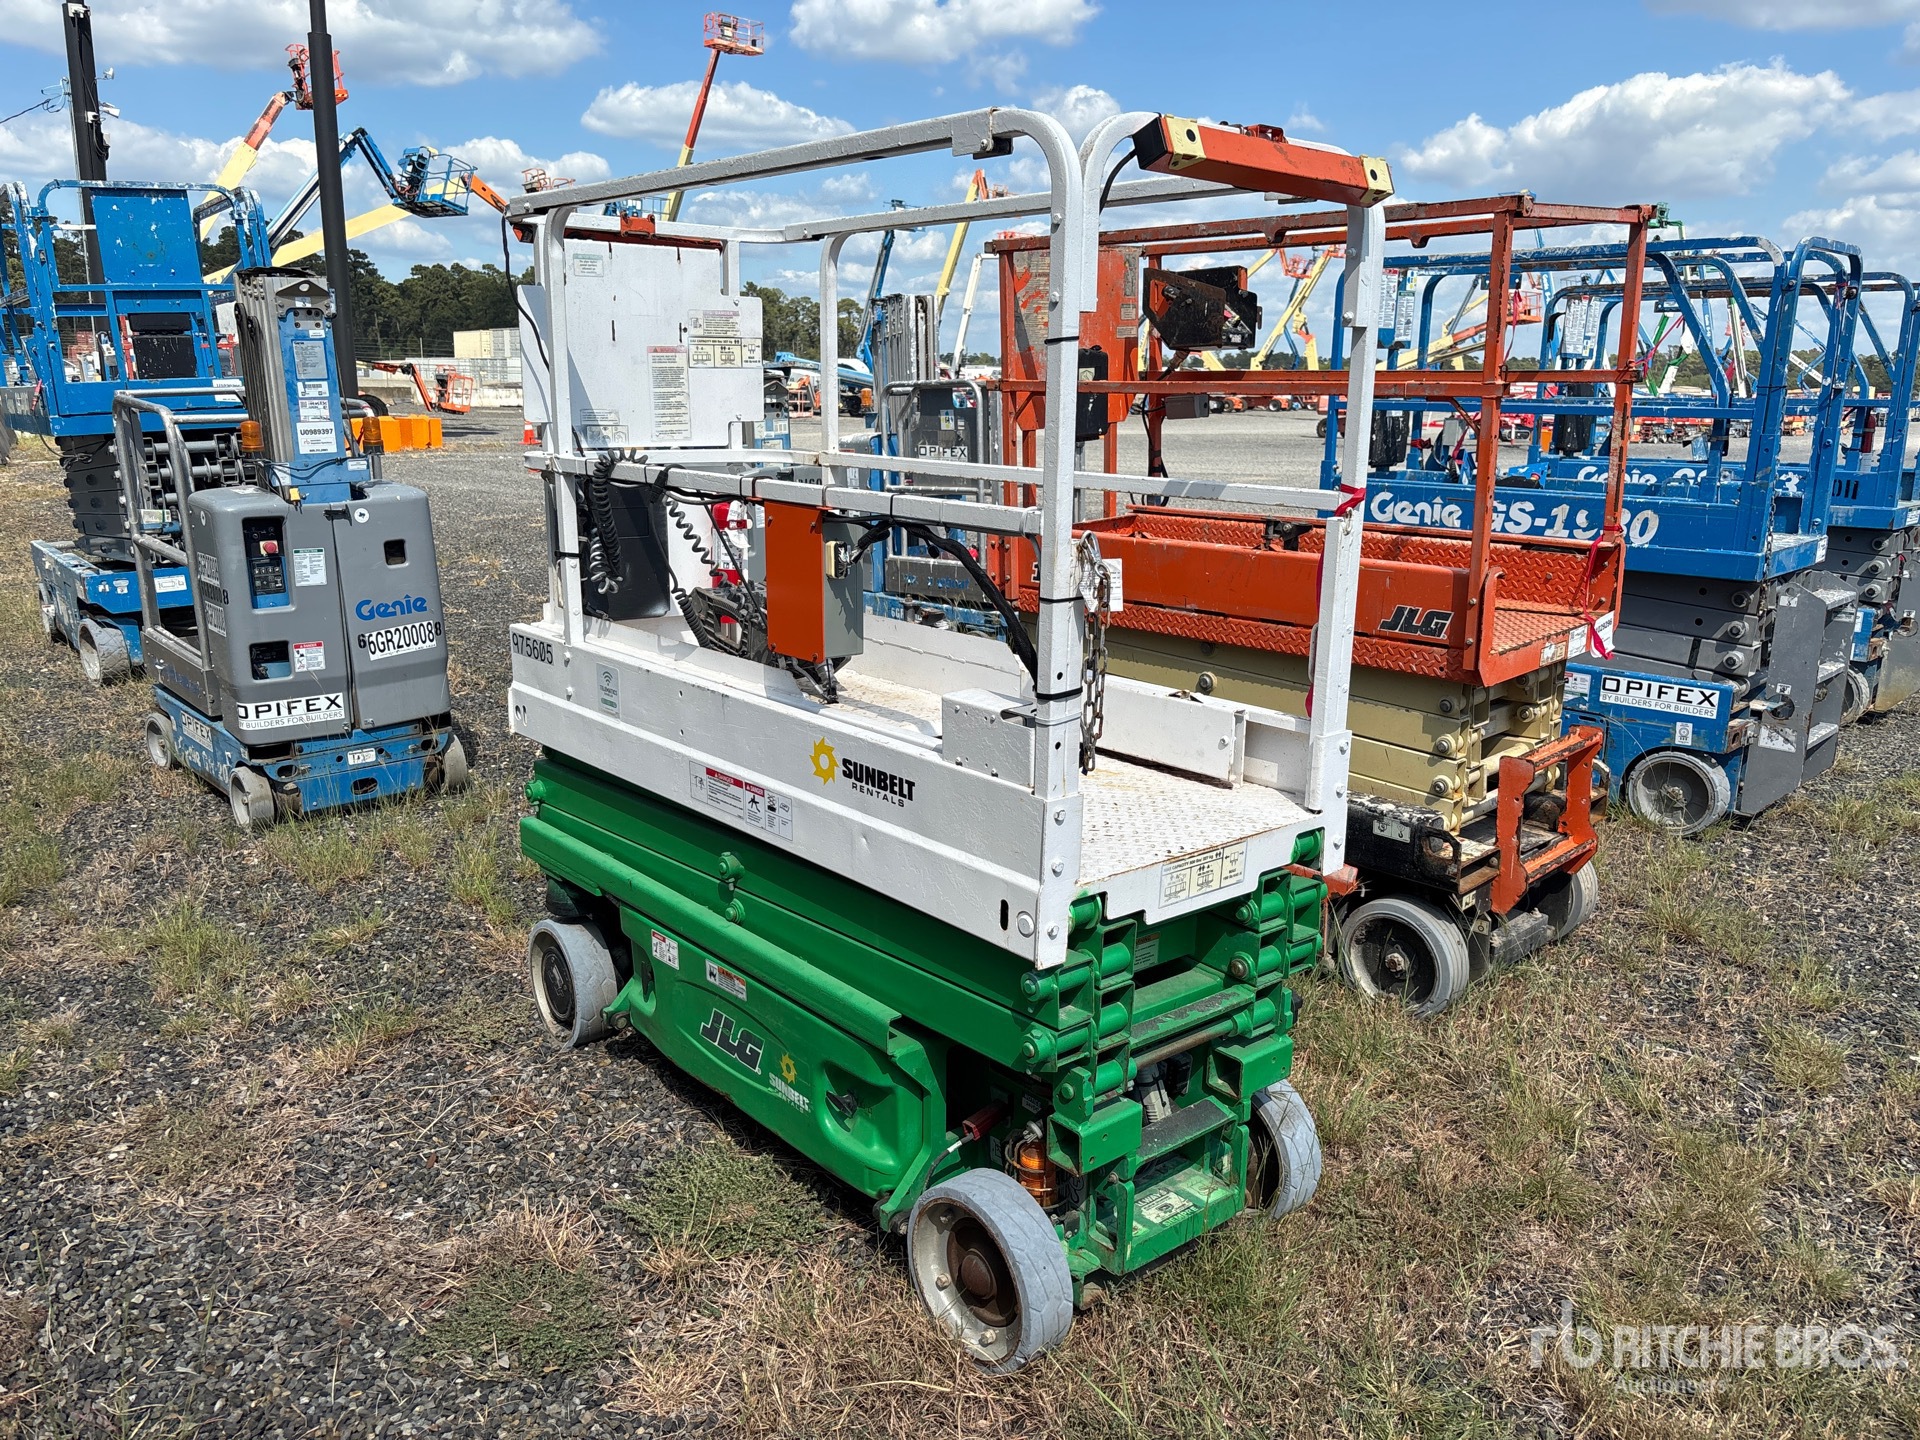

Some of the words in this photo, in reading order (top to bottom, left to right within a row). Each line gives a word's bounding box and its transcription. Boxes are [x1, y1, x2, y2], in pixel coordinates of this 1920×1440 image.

[299, 428, 334, 436] U0989397
[1370, 491, 1463, 528] Genie
[355, 594, 428, 621] Genie
[1378, 605, 1454, 639] JLG
[512, 632, 553, 664] 975605
[238, 695, 342, 719] OPIFEX
[1602, 677, 1717, 708] OPIFEX
[1602, 693, 1613, 701] BY
[1614, 695, 1652, 707] BUILDERS
[1654, 701, 1672, 710] FOR
[1674, 704, 1715, 717] BUILDERS
[246, 718, 285, 729] BUILDERS
[287, 716, 305, 726] FOR
[306, 711, 343, 722] BUILDERS
[842, 757, 916, 802] SUNBELT
[851, 782, 905, 808] RENTALS
[700, 1008, 765, 1074] JLG
[769, 1072, 810, 1112] SUNBELT
[1134, 1187, 1168, 1207] LWAYS
